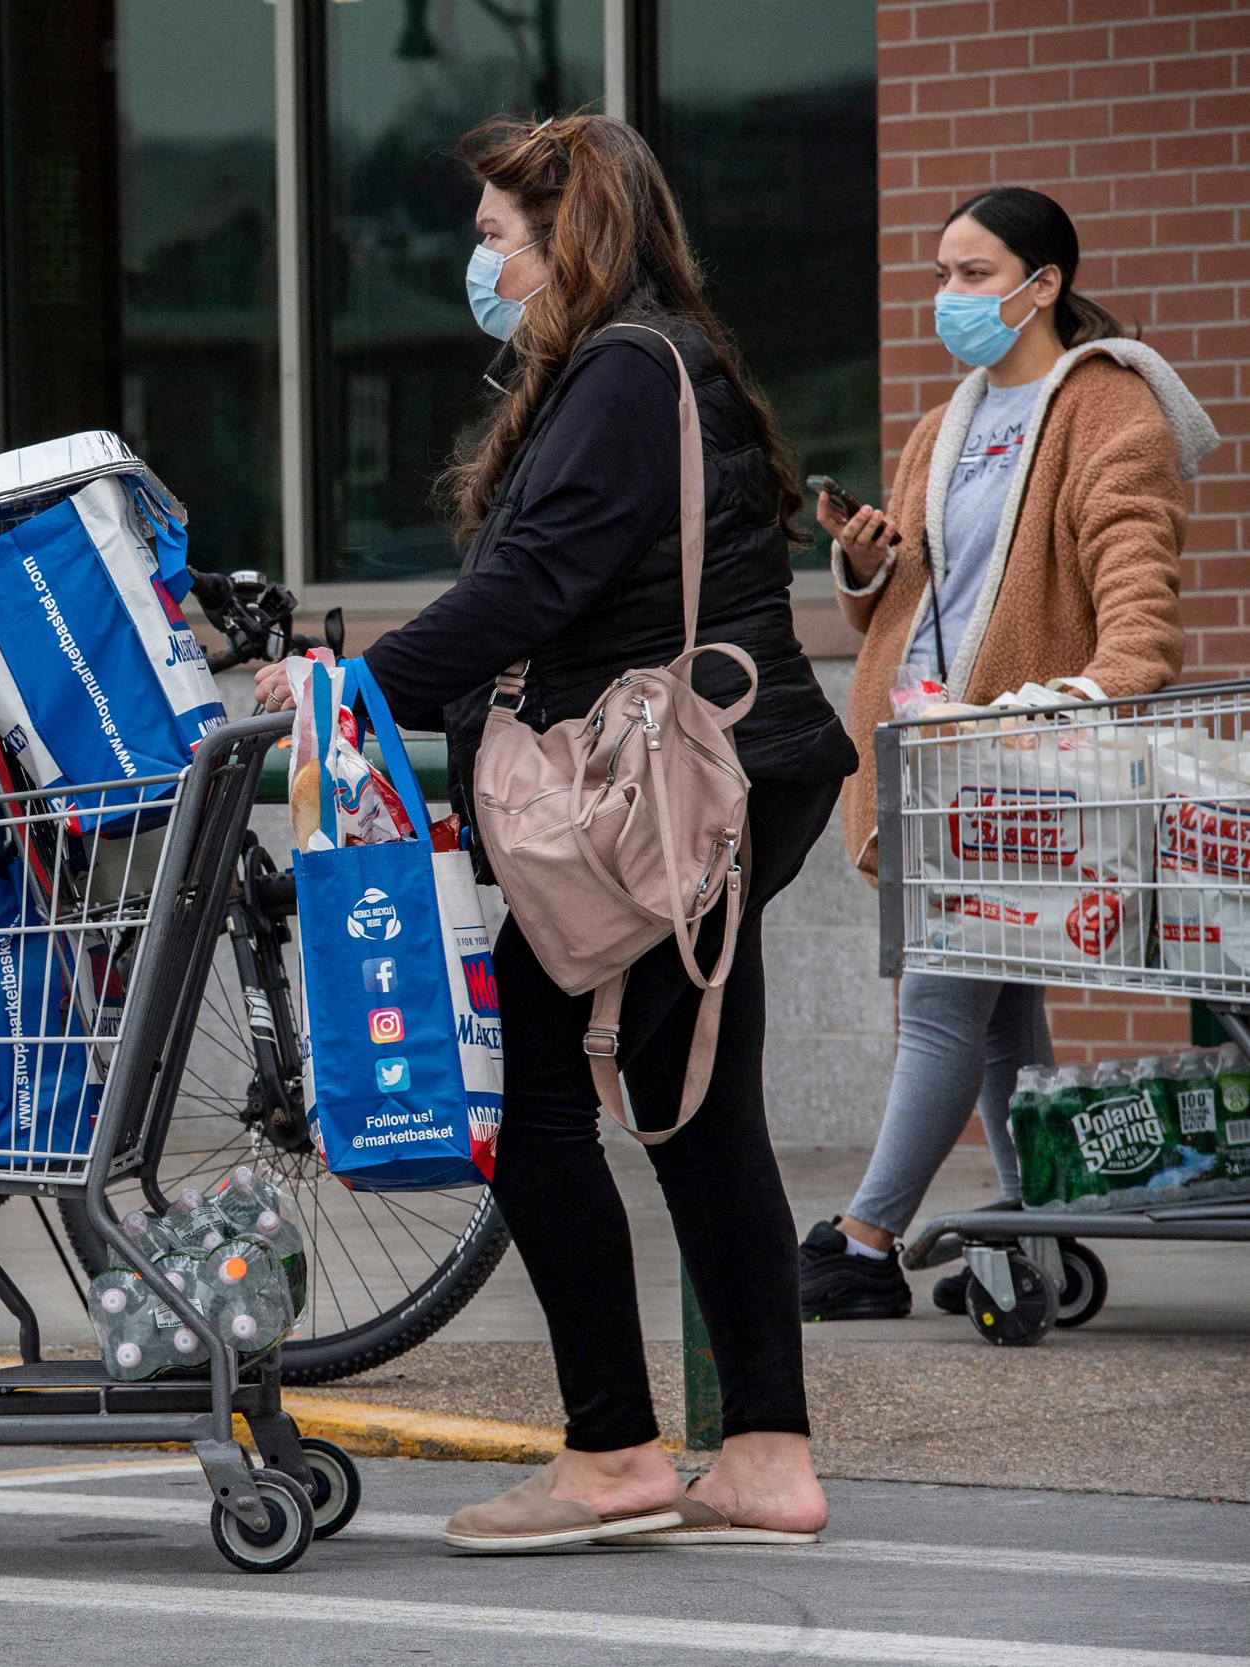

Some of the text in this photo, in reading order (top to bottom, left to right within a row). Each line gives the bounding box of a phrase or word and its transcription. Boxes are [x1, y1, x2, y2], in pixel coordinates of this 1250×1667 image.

[22, 555, 135, 778] www.shopmarketbasket.com
[366, 918, 382, 928] REUSE
[352, 1125, 454, 1149] @marketbasket
[365, 1108, 434, 1129] Follow us!
[1071, 1089, 1158, 1147] Poland
[1080, 1118, 1165, 1173] Spring
